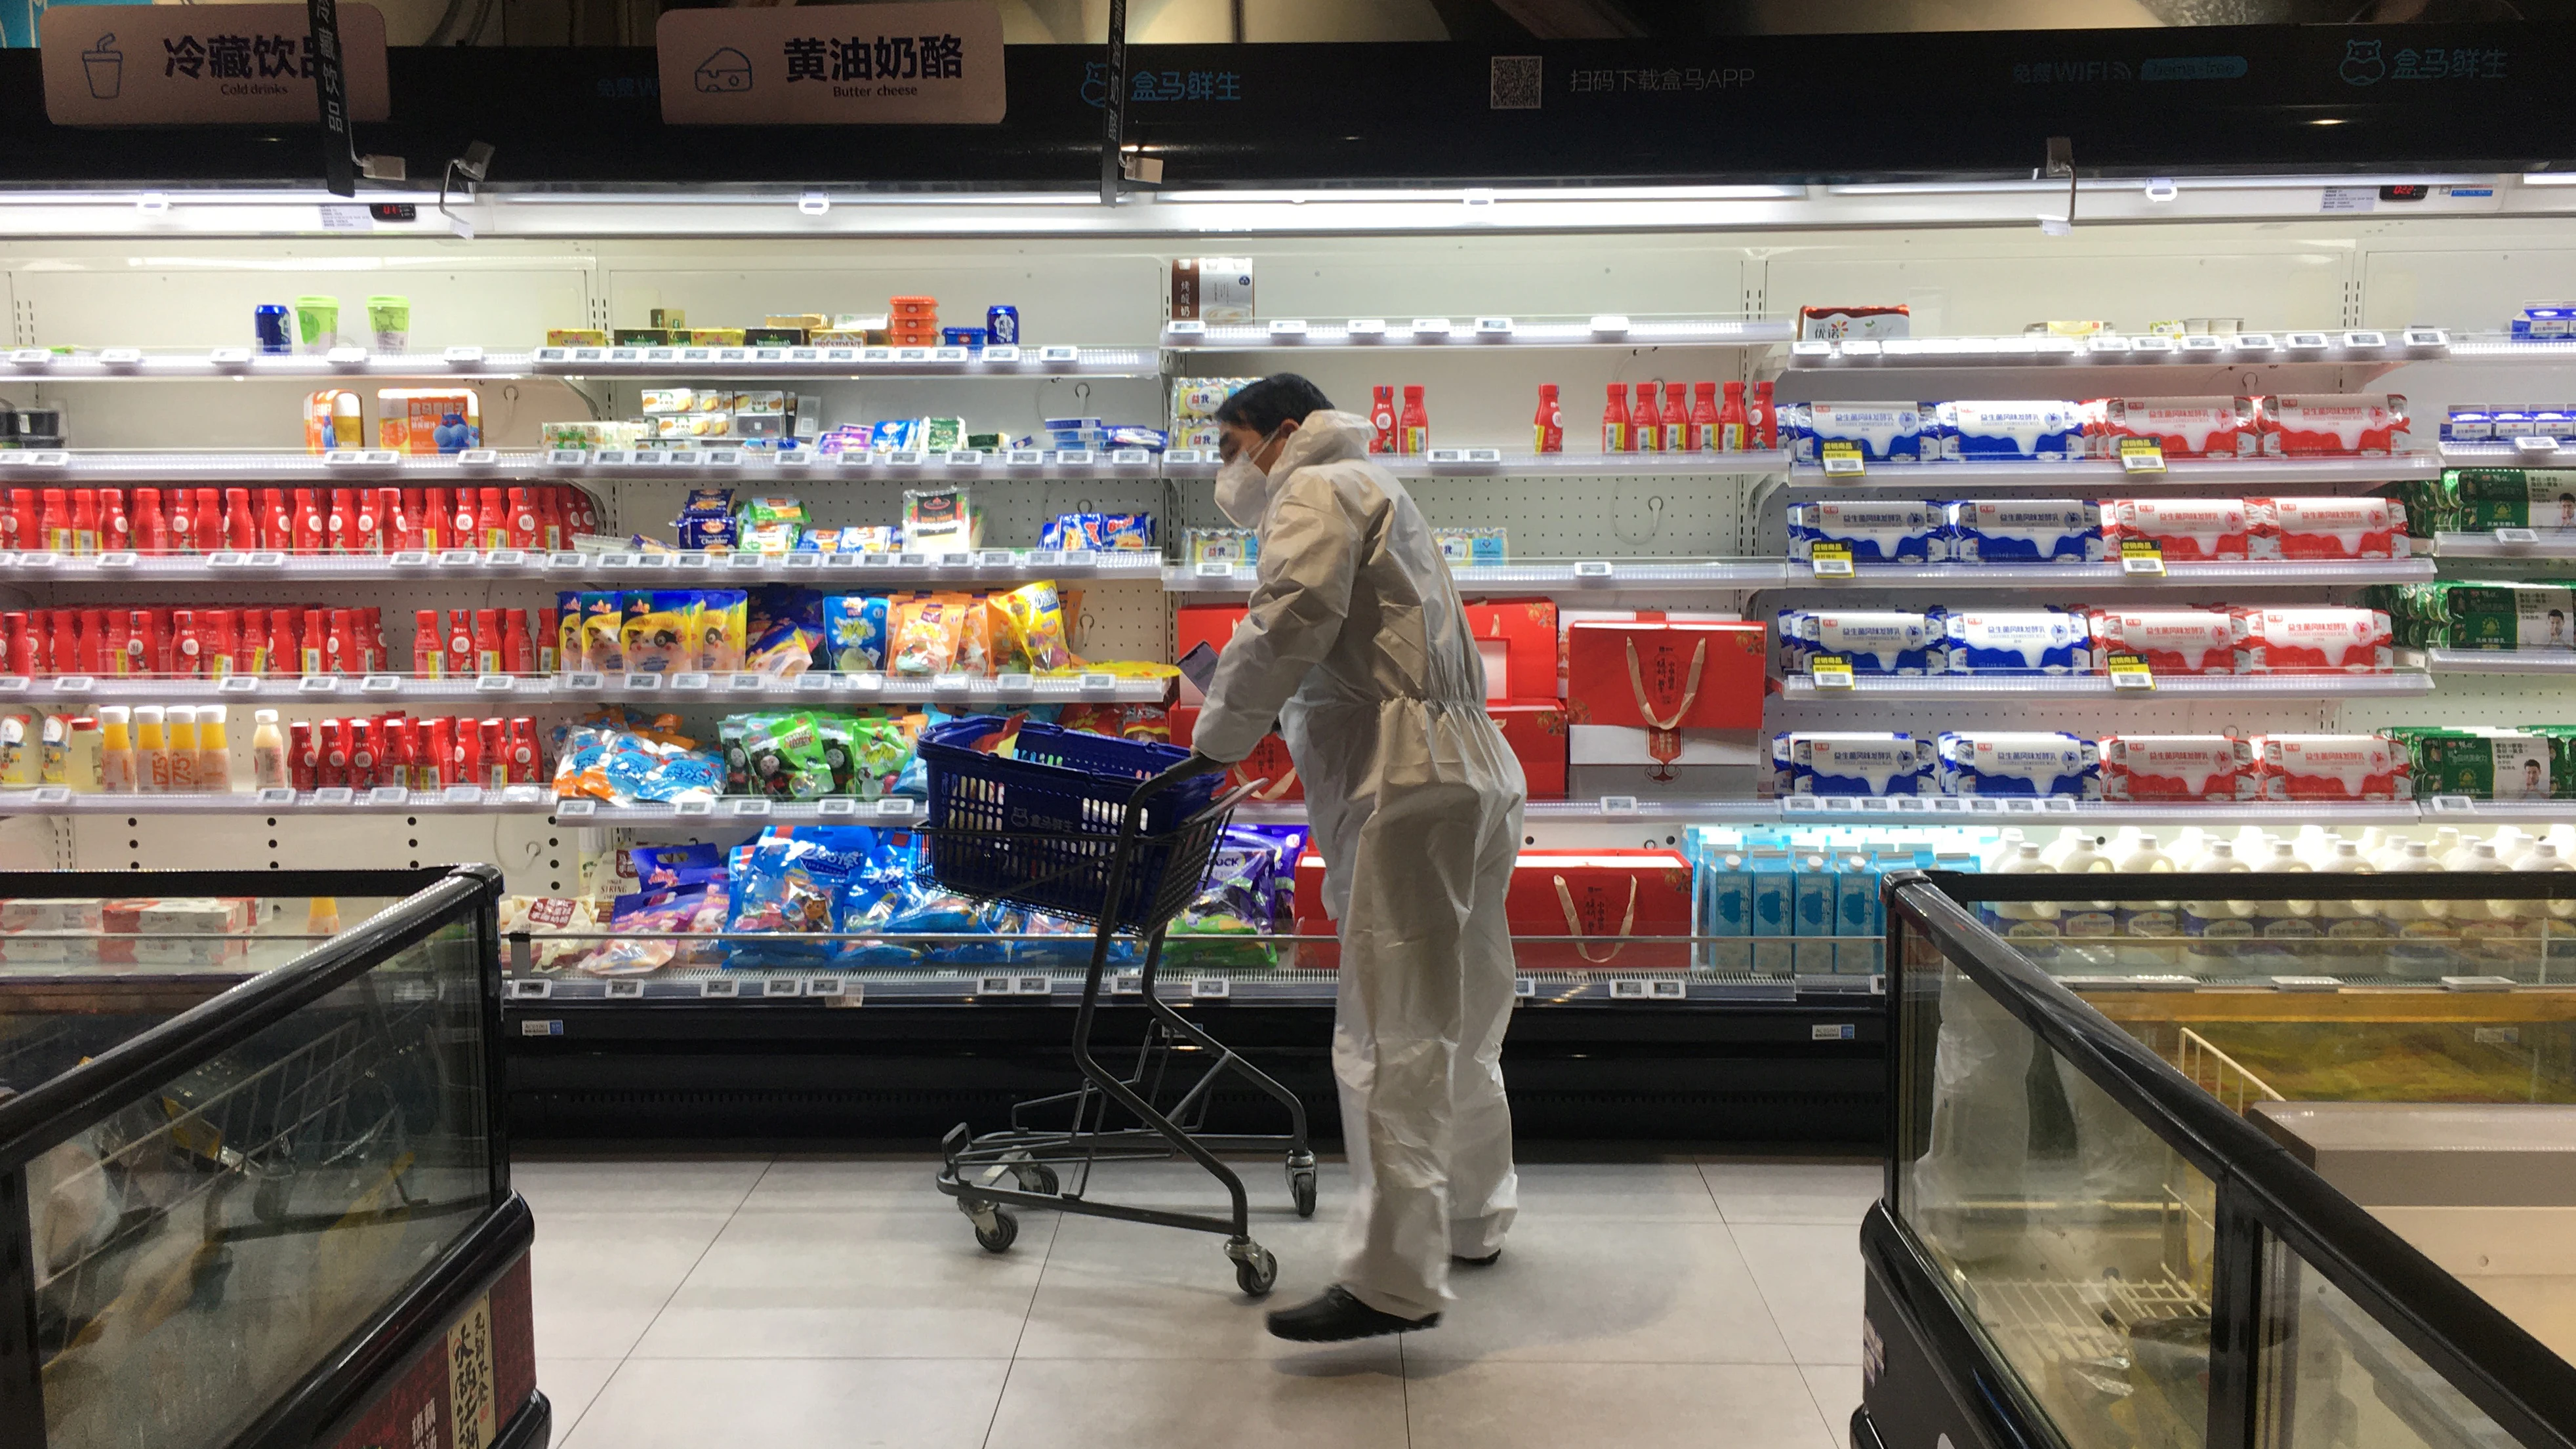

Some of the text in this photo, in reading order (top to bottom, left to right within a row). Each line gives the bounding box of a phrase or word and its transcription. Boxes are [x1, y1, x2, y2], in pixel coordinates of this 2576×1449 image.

[784, 33, 964, 82] 黄油奶酪
[2391, 47, 2508, 80] 盒马鲜生
[220, 83, 289, 96] Cold drinks
[832, 83, 918, 98] Butter cheese
[1131, 70, 1241, 102] 盒马鲜生
[1569, 68, 1755, 92] 扫码下载盒马APP
